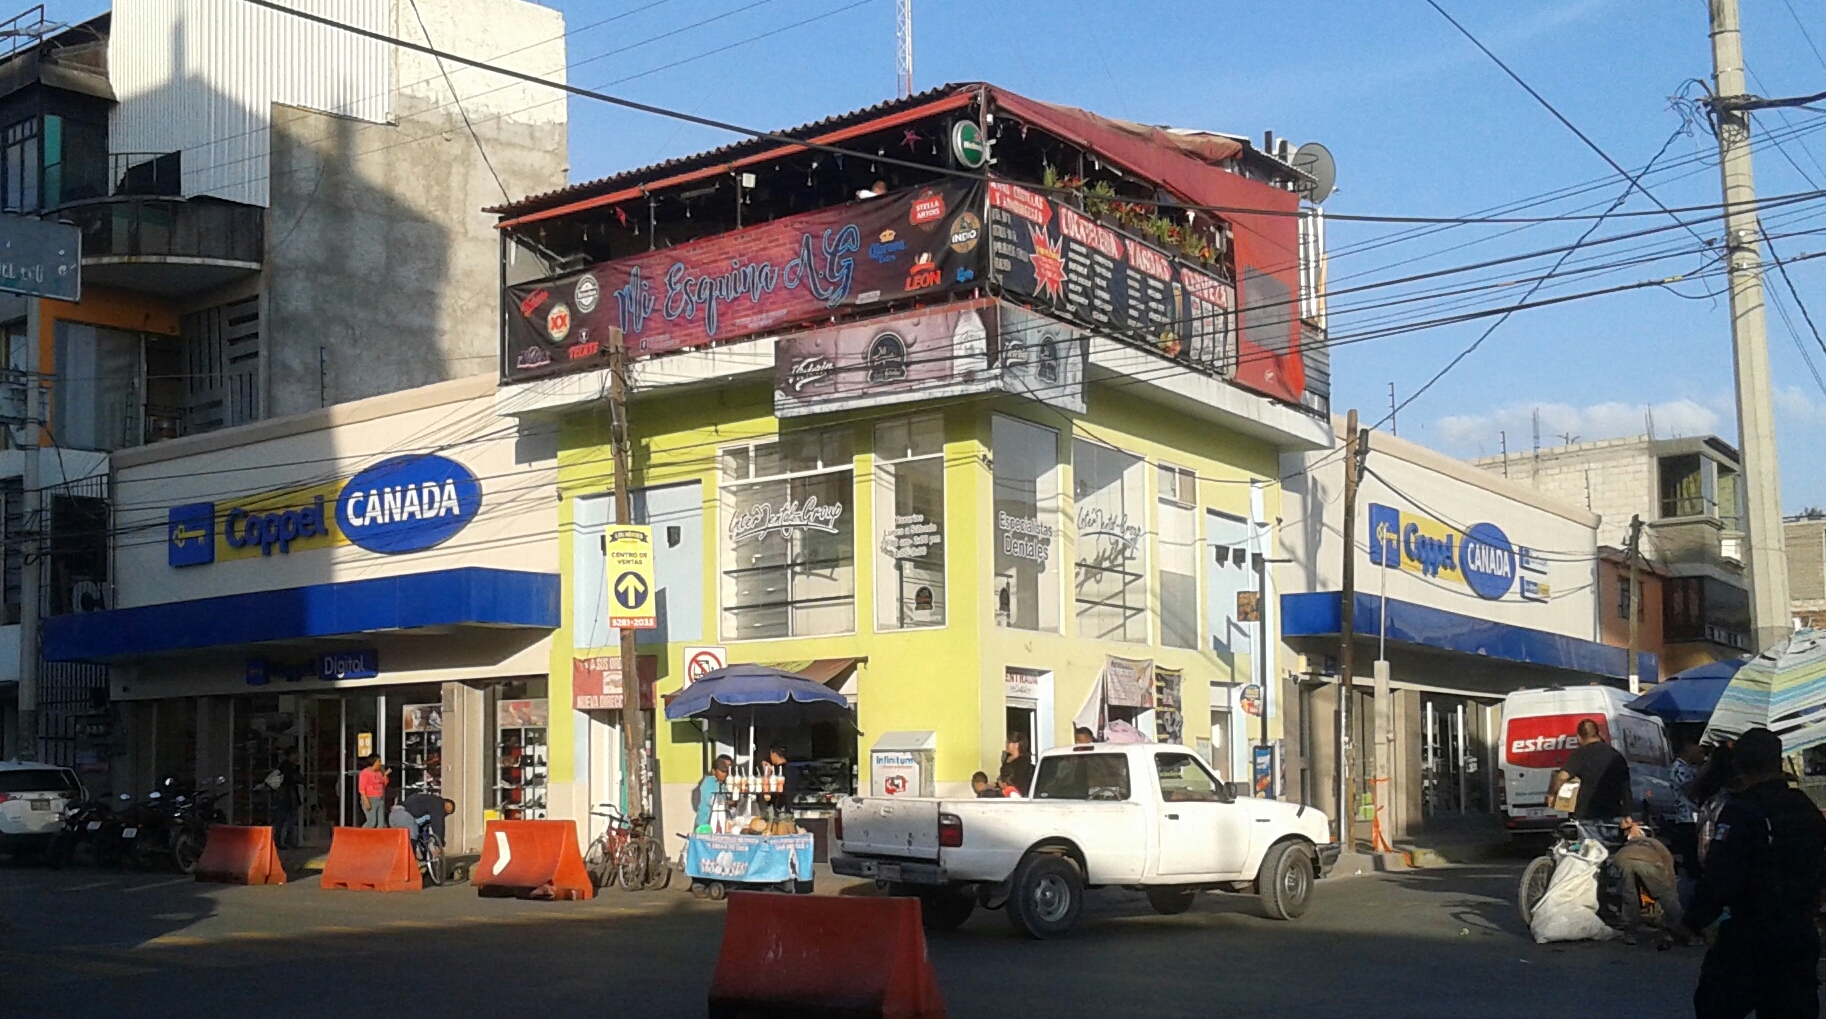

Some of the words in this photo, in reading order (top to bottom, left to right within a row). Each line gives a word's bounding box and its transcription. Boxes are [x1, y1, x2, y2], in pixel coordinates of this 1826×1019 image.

[951, 229, 977, 243] INDIO
[613, 265, 655, 333] Mi
[663, 259, 780, 336] Esquina
[224, 494, 329, 557] Coppel
[346, 478, 460, 527] CANADA
[998, 511, 1053, 538] Especialistas
[1003, 533, 1049, 561] Dentales
[1403, 522, 1457, 578] Coppel
[1467, 542, 1511, 578] CANADA
[324, 654, 366, 678] Digital
[1511, 734, 1578, 754] estafe
